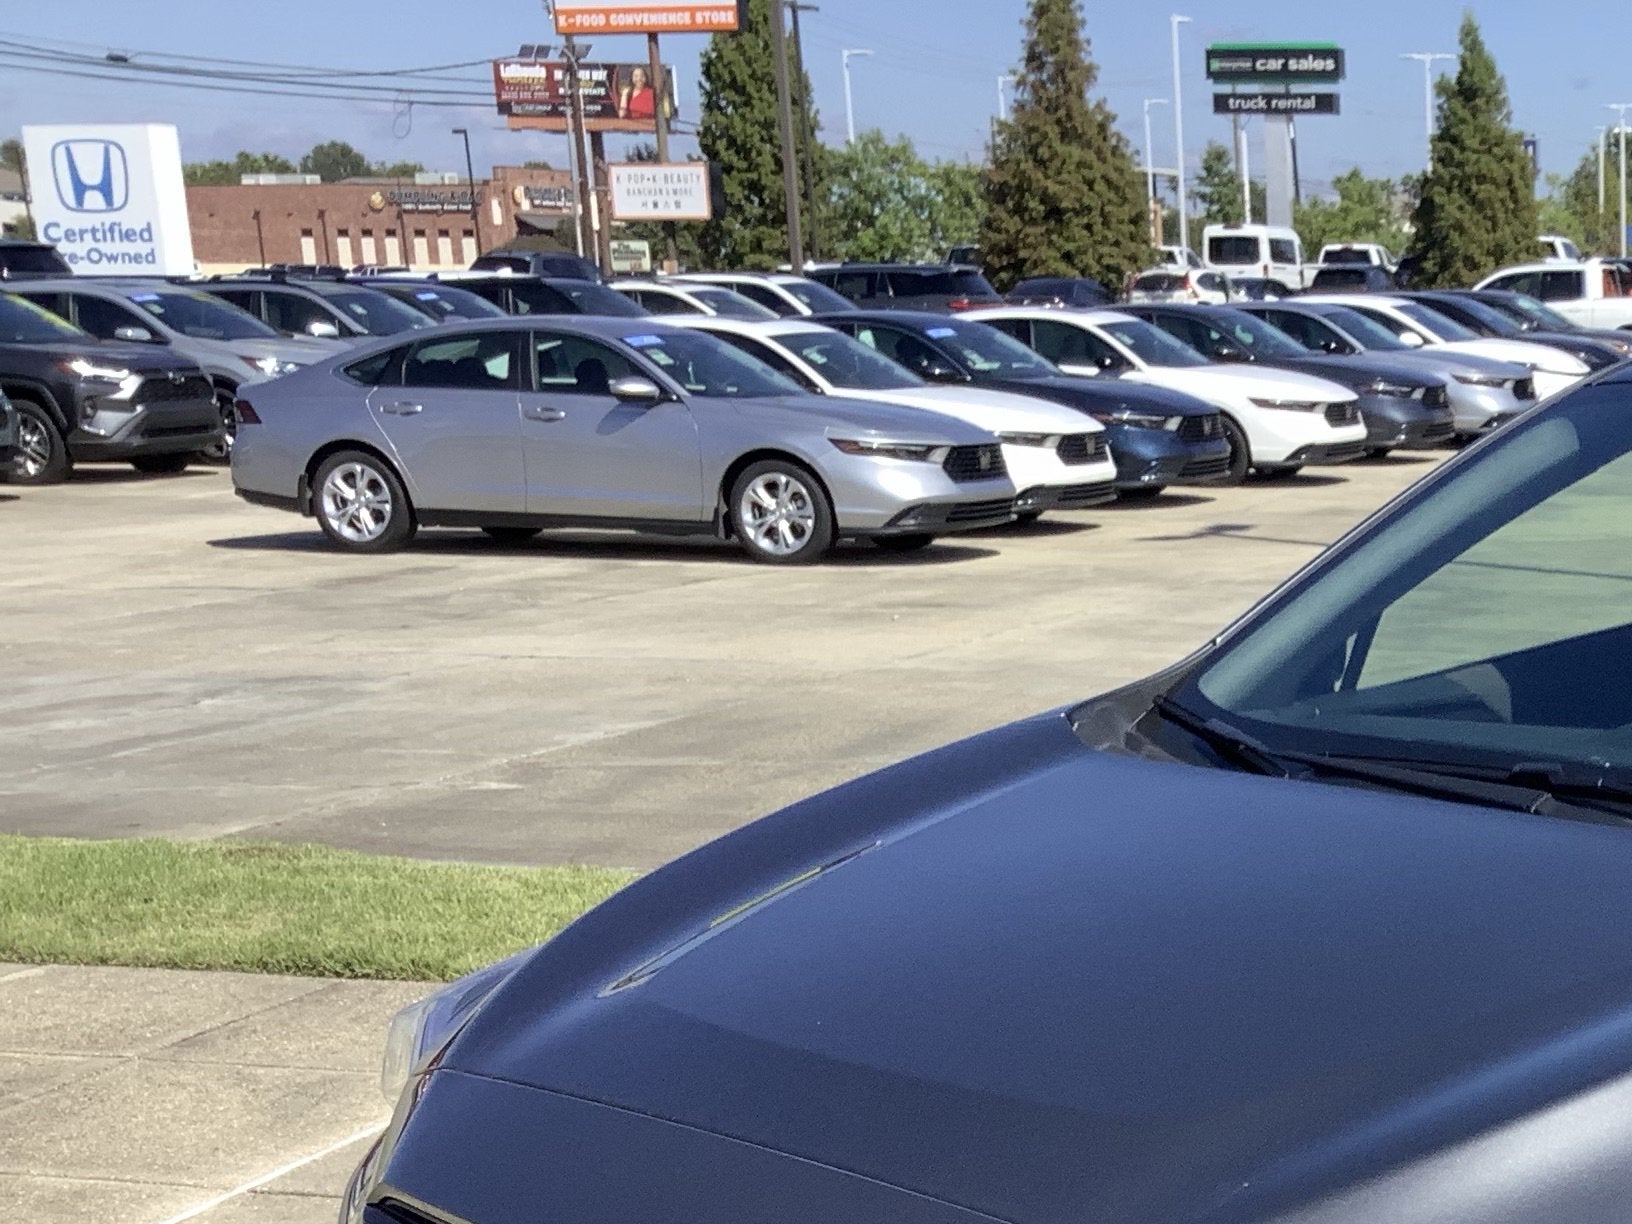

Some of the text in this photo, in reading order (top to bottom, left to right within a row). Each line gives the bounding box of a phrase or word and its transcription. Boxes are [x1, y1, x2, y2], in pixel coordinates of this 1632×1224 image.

[558, 10, 735, 27] K-FOOD CONVENIENCE STORE
[1255, 57, 1286, 72] car
[1287, 53, 1336, 72] sales
[1228, 94, 1316, 110] truck rental
[43, 221, 153, 243] Certified
[63, 247, 156, 265] e-Owned
